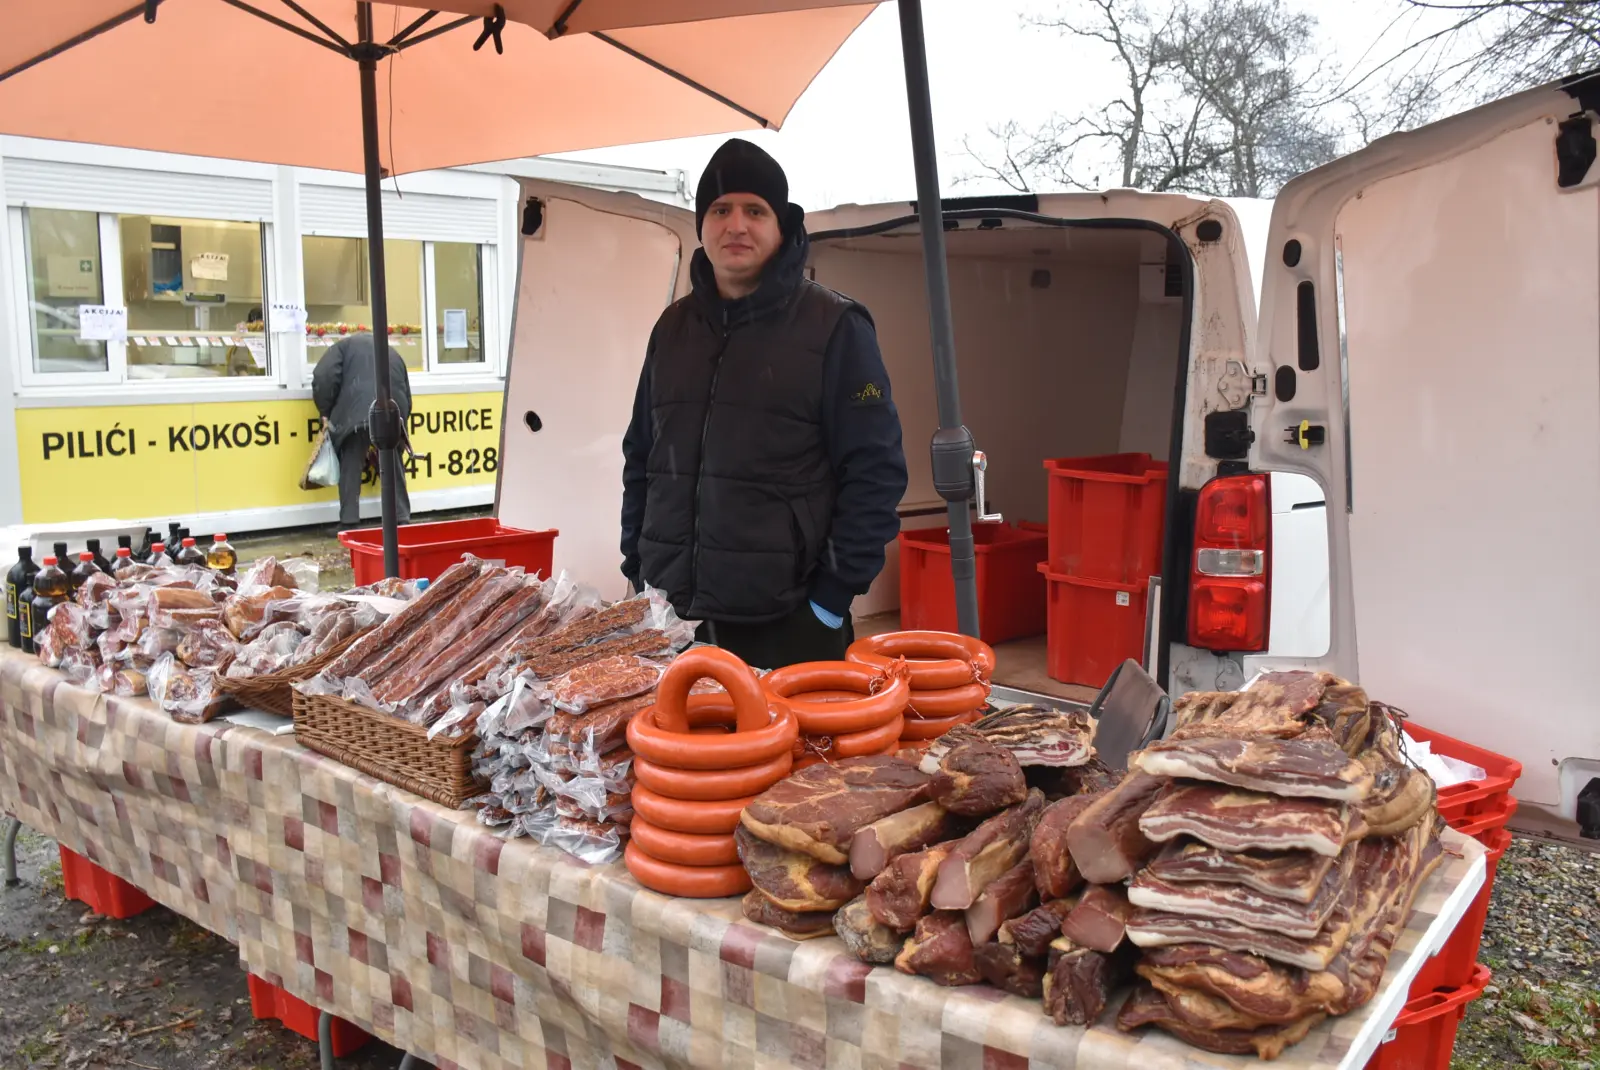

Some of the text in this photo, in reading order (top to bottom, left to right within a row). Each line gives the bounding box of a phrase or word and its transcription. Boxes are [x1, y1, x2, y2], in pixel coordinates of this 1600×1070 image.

[42, 422, 136, 460] PILIĆI
[168, 414, 280, 452] KOKOŠI
[410, 408, 493, 435] PURICE
